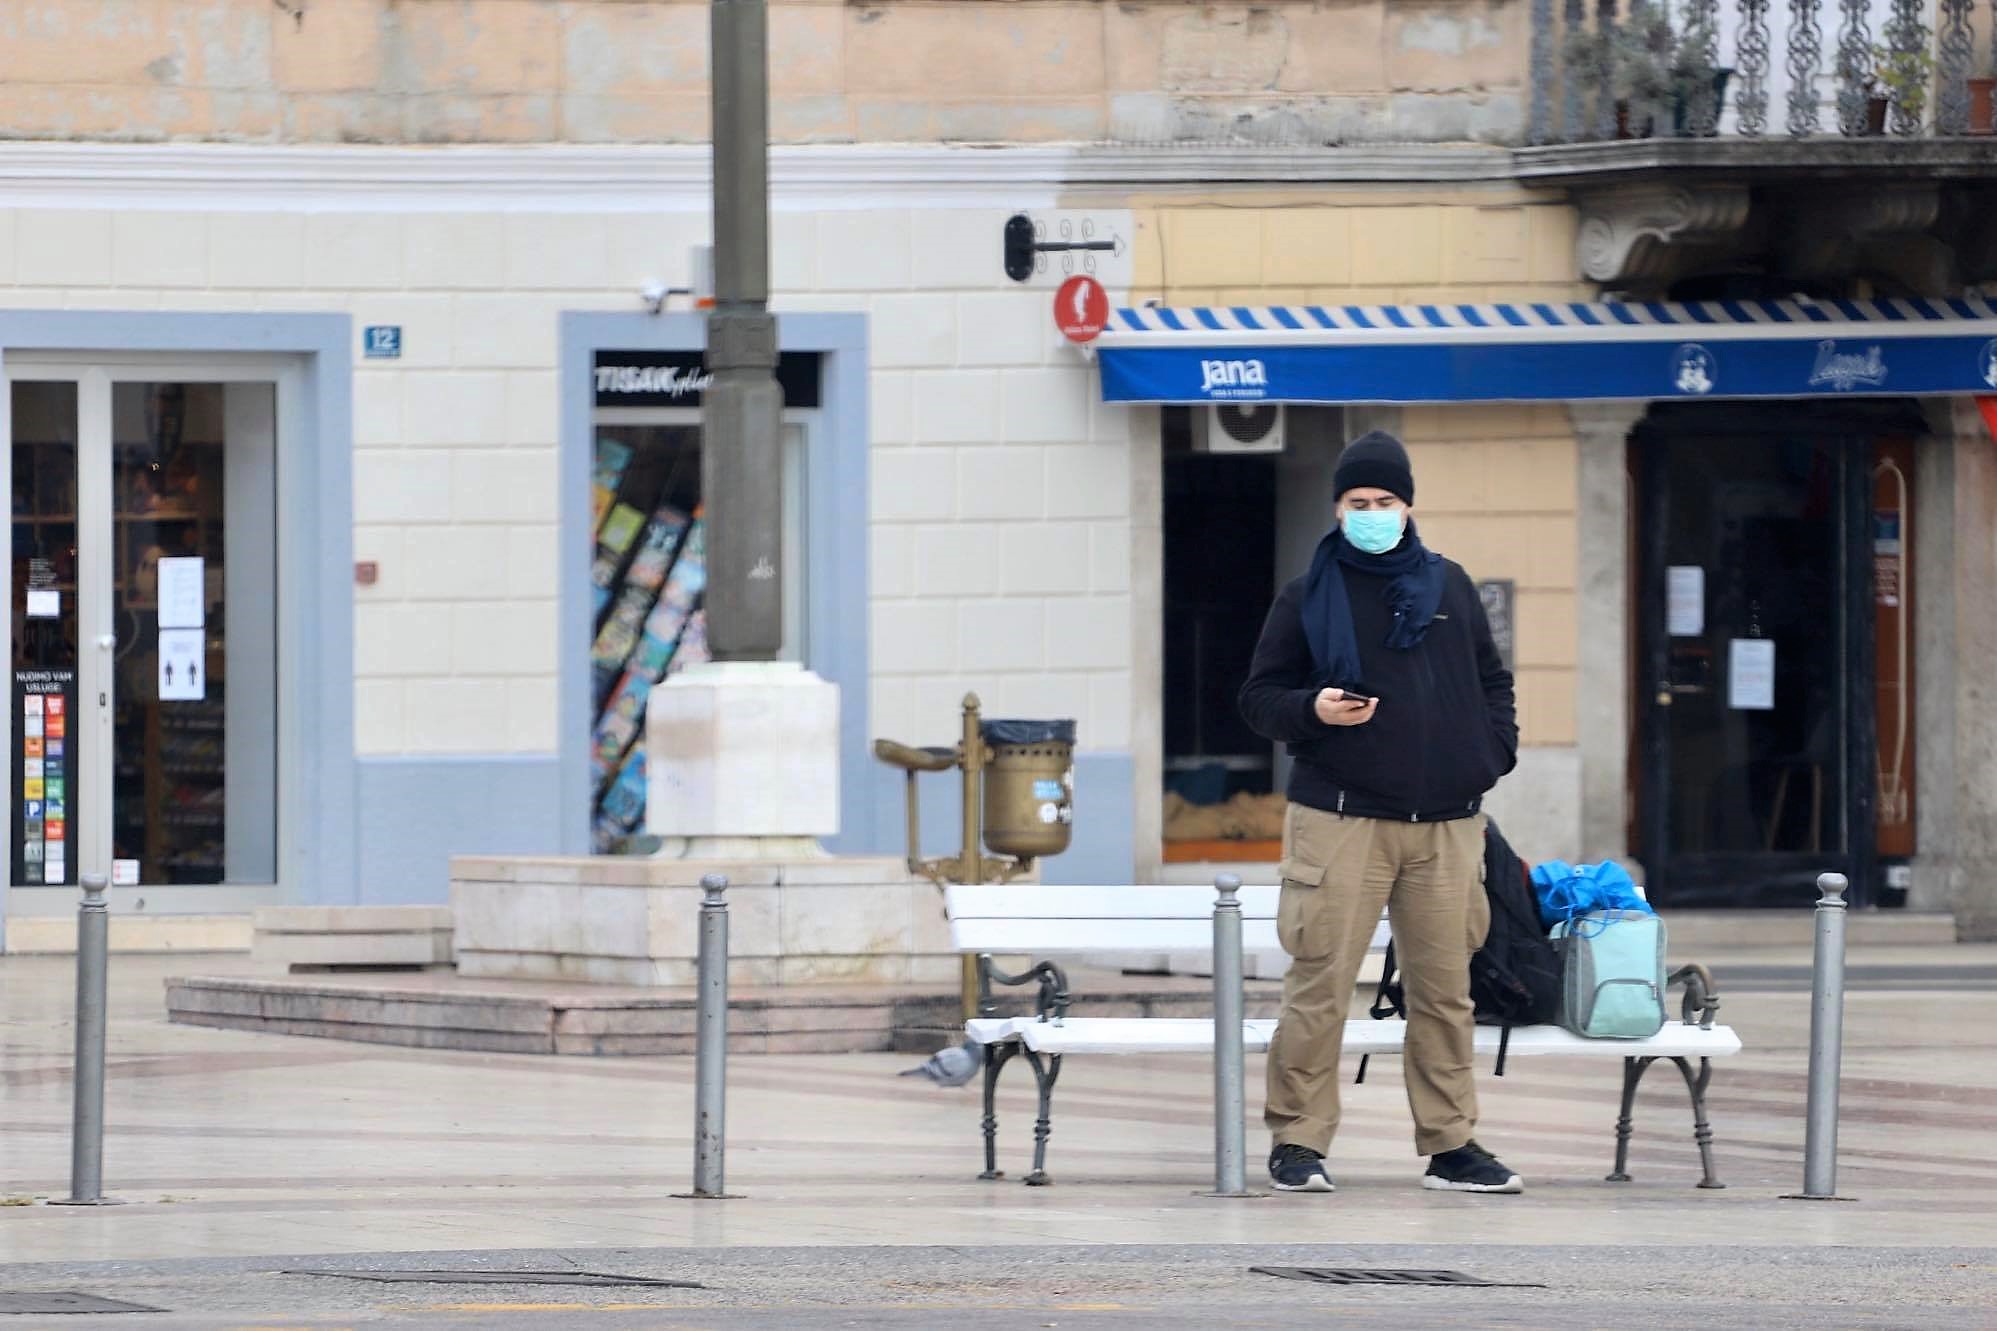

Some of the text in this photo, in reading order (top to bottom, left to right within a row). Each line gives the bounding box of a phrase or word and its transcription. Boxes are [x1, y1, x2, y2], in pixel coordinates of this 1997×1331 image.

[373, 329, 393, 348] 12
[594, 366, 679, 392] TISAK
[1200, 359, 1268, 391] jana
